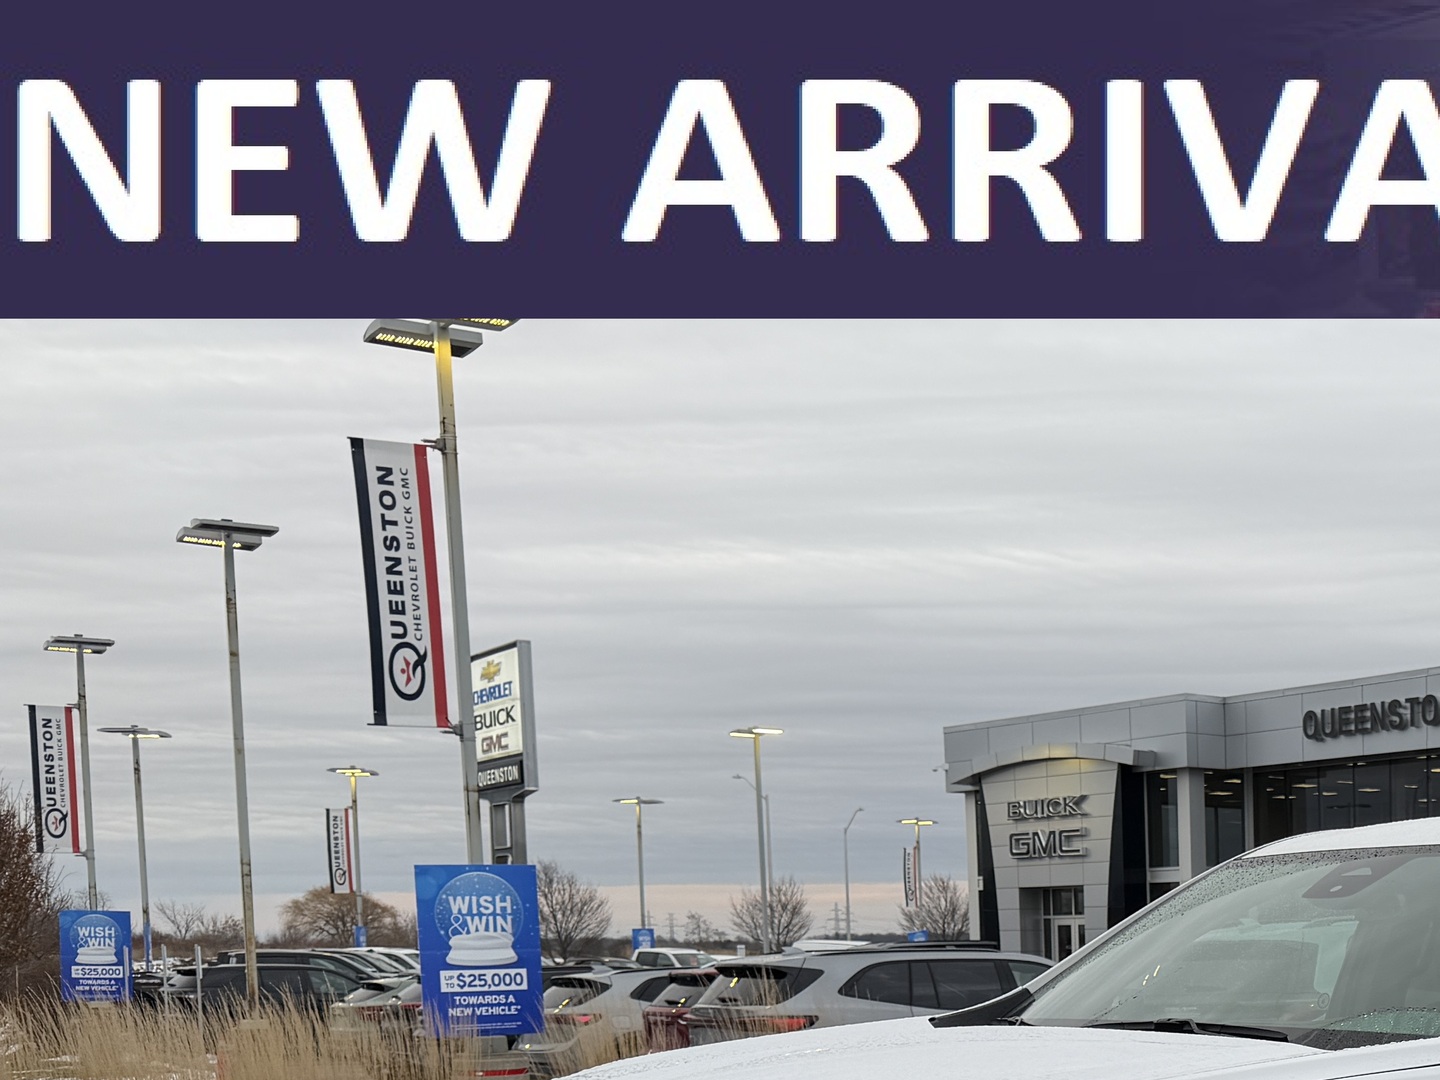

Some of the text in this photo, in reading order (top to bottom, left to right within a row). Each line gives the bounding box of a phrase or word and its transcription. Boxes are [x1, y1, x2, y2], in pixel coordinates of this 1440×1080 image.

[399, 467, 423, 642] CHEVROLET BUICK GMC
[375, 465, 428, 701] QUEENSTON
[473, 681, 513, 706] CHEVROLET
[474, 705, 516, 731] BUICK
[481, 732, 509, 756] GMC
[42, 718, 68, 839] QUEENSTON
[478, 765, 519, 788] QUEENSTON
[1007, 794, 1087, 821] BUICK
[1008, 827, 1087, 860] GMC
[448, 895, 512, 914] WISH
[77, 926, 115, 937] WISH
[80, 967, 121, 976] $25,000
[456, 972, 524, 989] $25,000
[448, 1006, 475, 1017] NEW
[454, 994, 516, 1005] TOWARDS A
